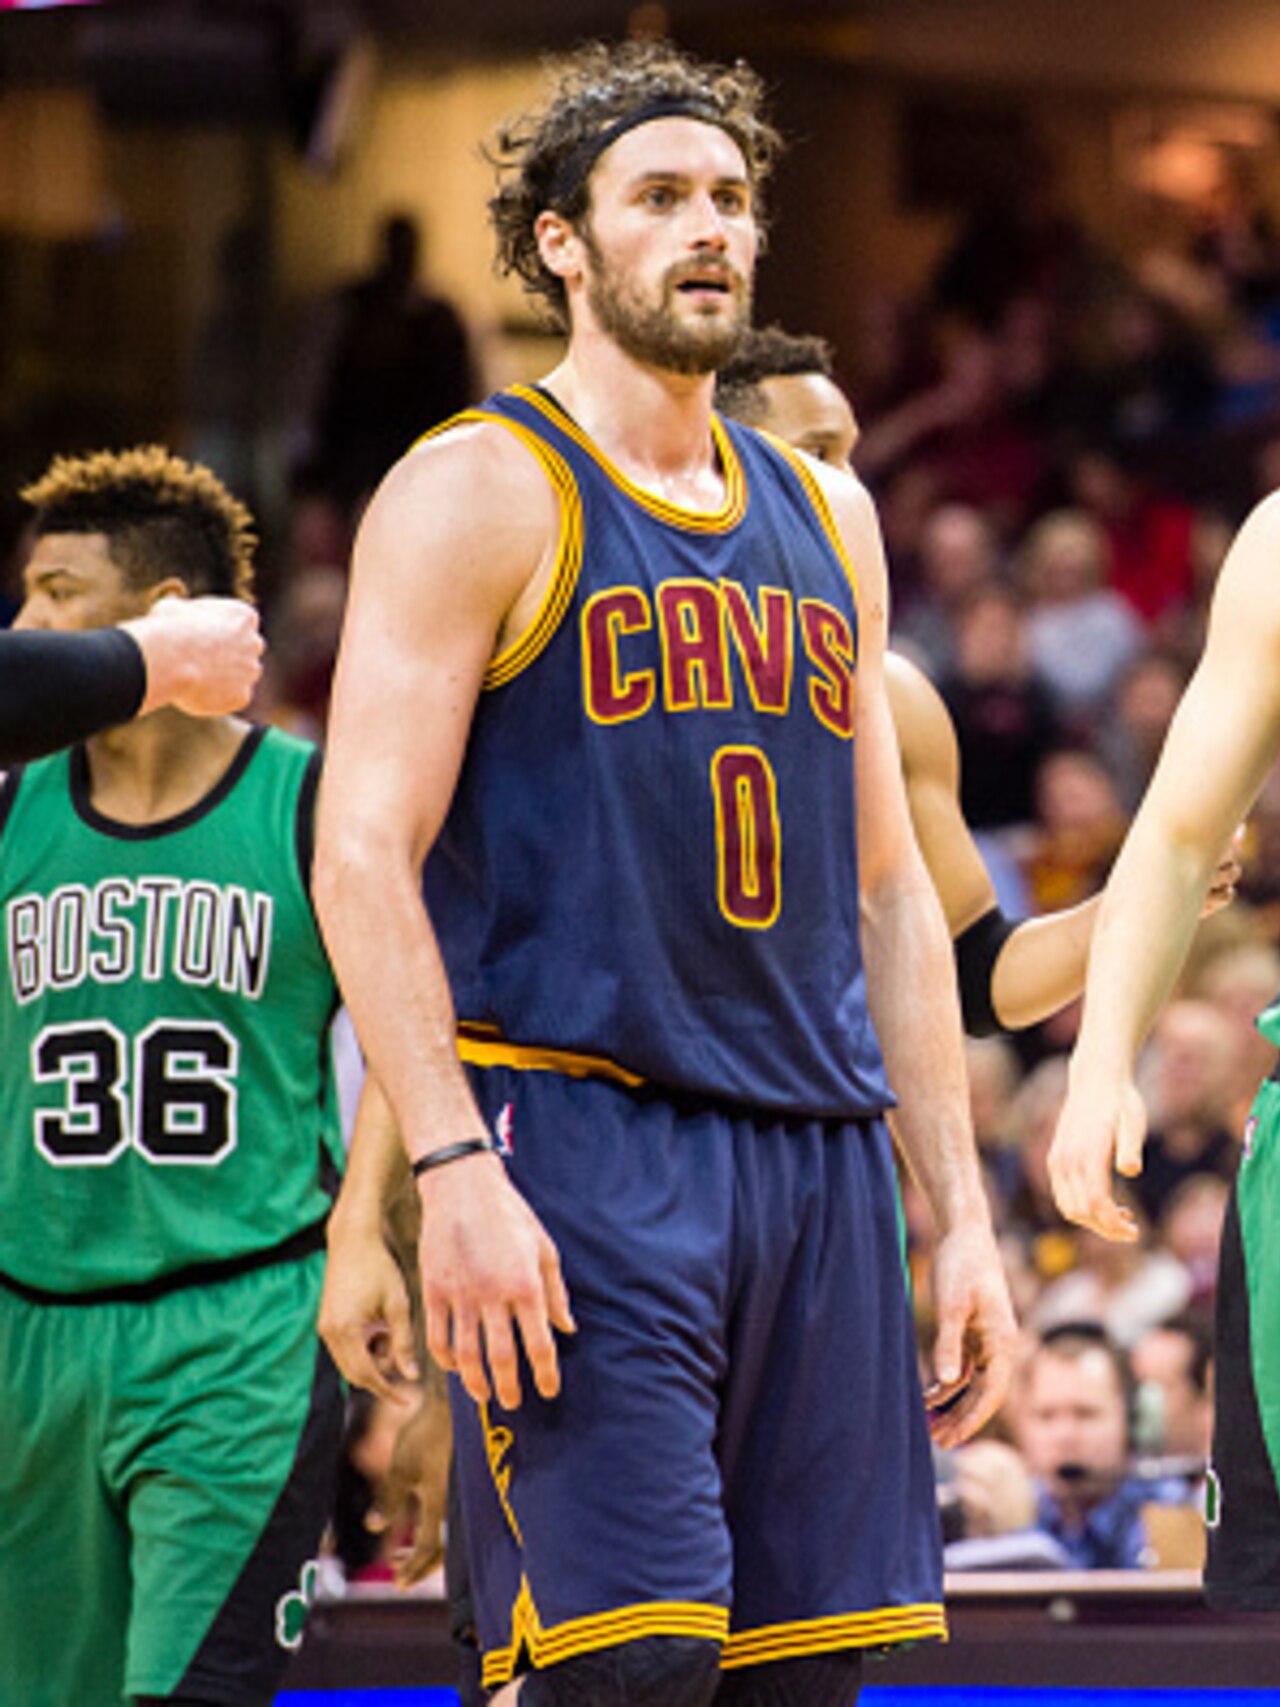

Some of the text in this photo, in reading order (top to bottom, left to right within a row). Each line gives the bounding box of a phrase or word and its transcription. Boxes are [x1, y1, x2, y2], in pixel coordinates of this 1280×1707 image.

[582, 577, 855, 738] CAVS
[711, 745, 782, 929] 0
[9, 876, 272, 1003] BOSTON
[33, 1019, 239, 1166] 36
